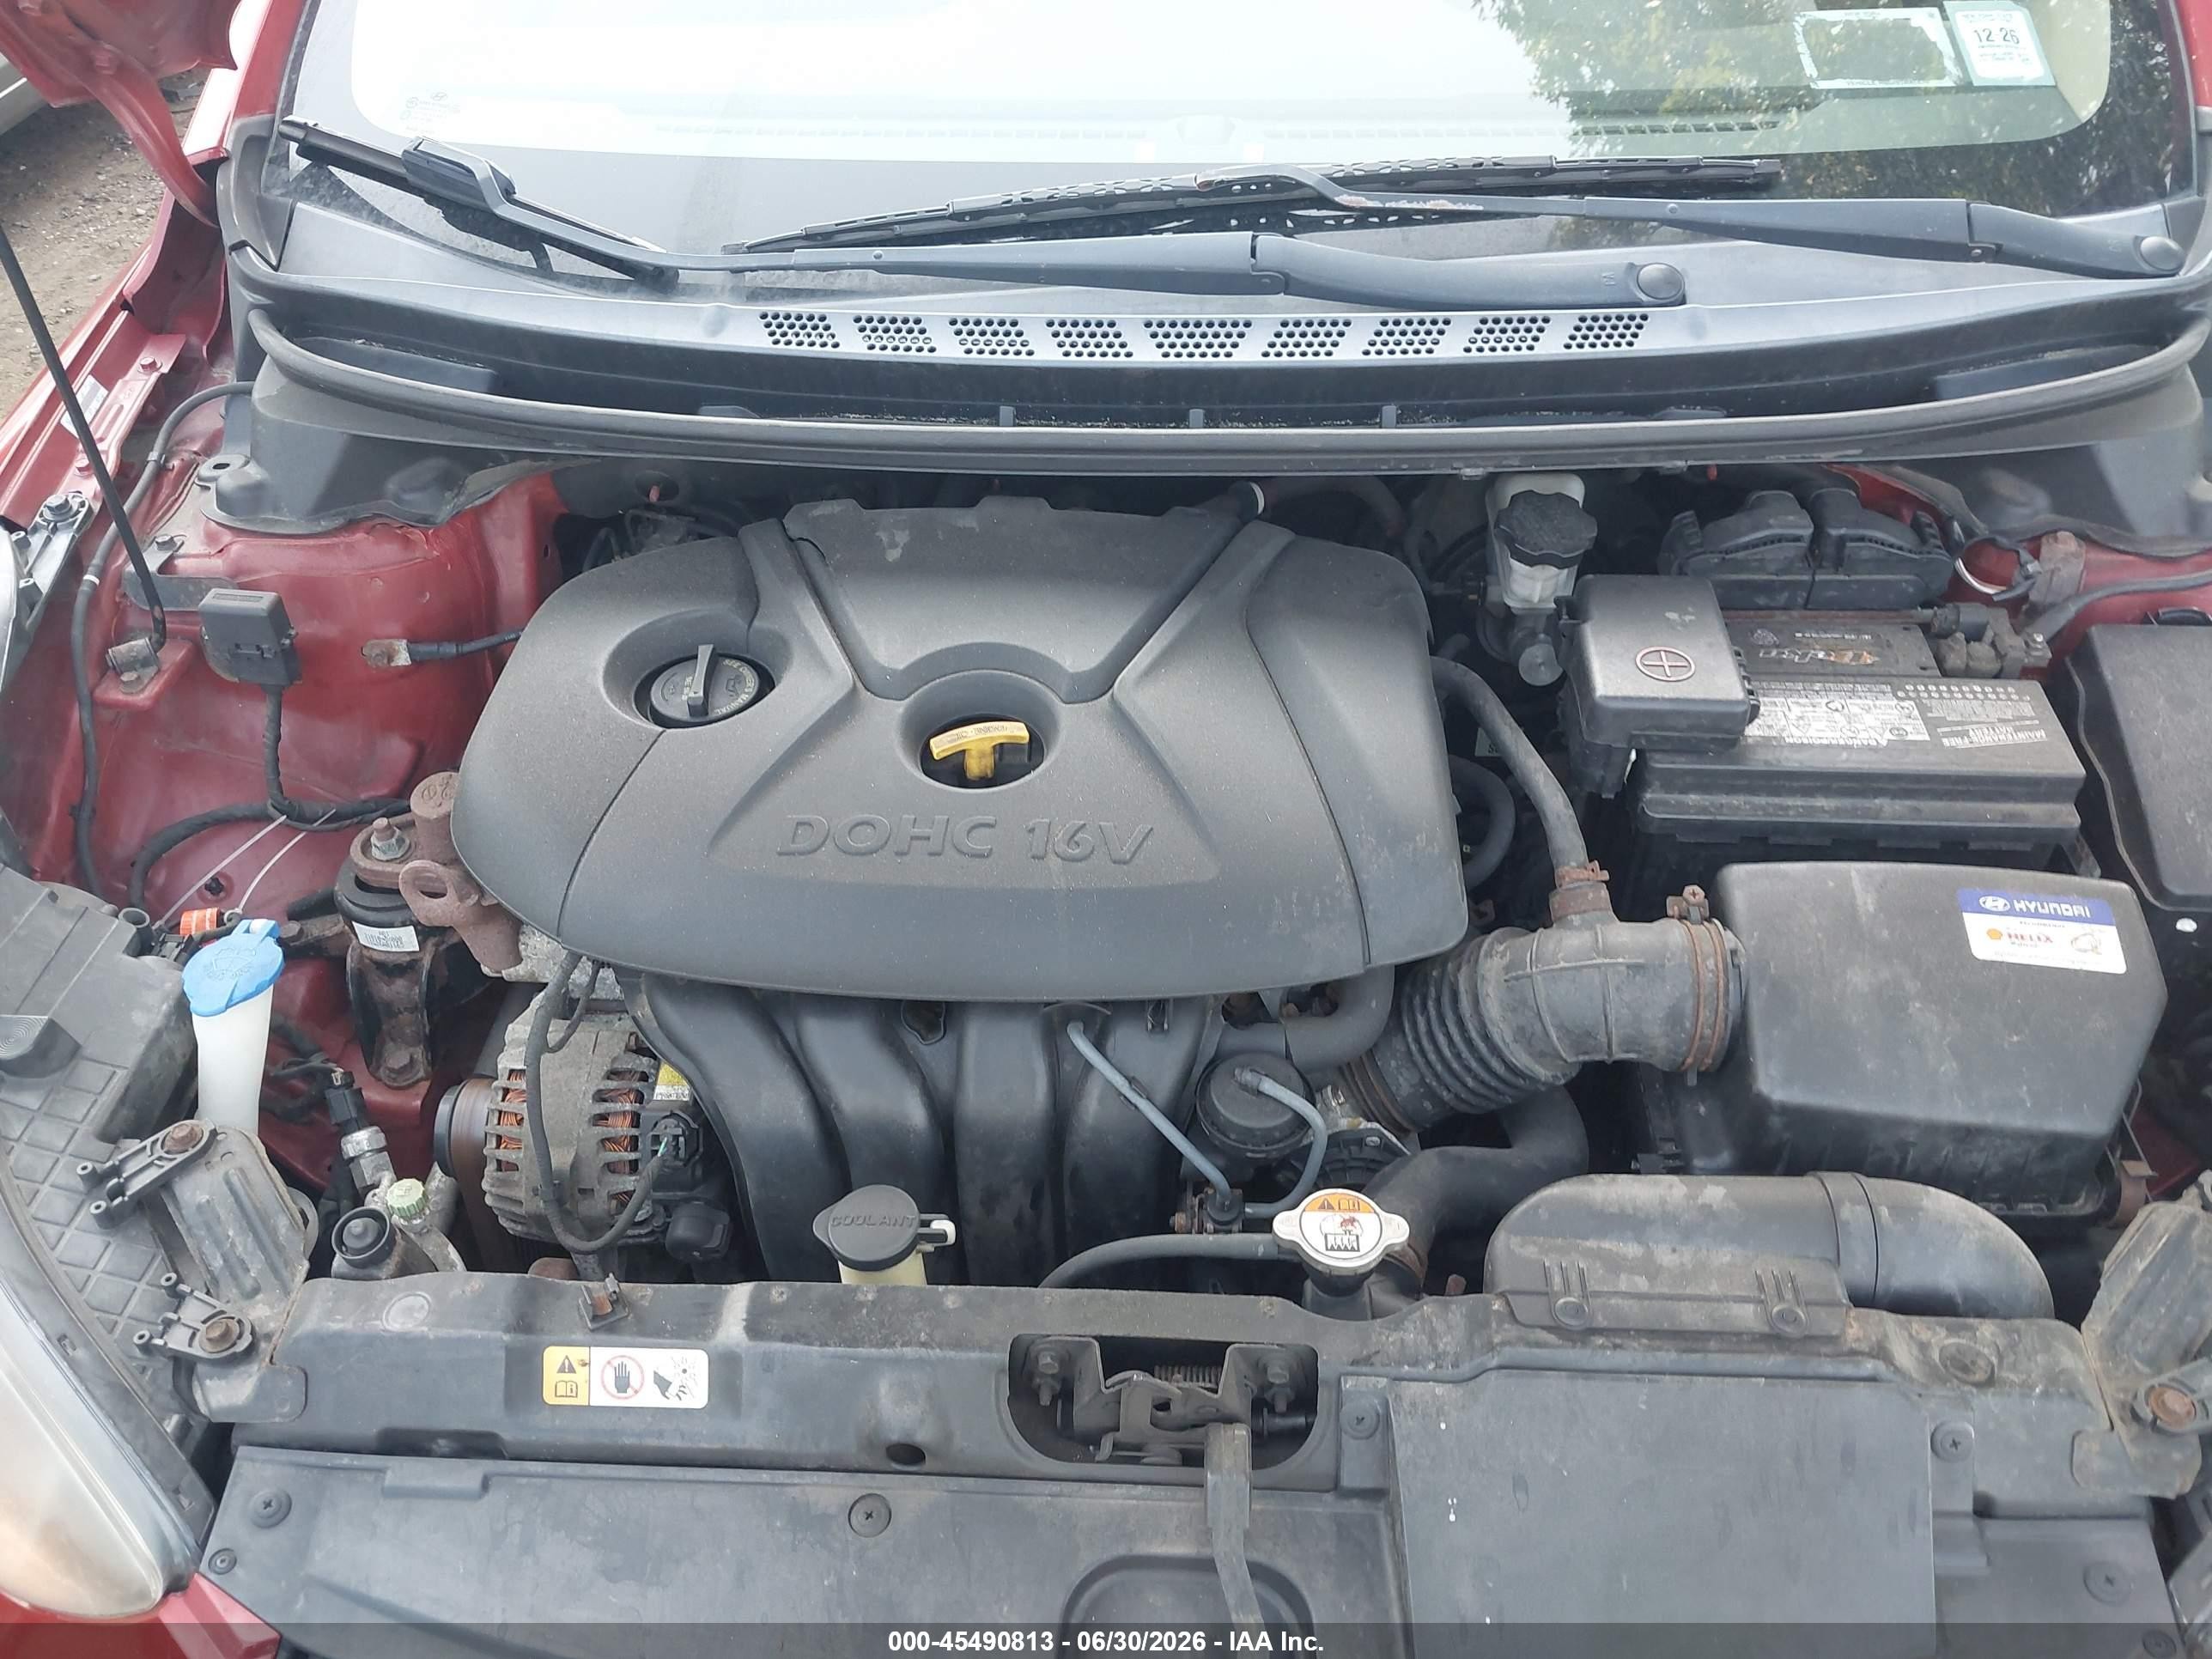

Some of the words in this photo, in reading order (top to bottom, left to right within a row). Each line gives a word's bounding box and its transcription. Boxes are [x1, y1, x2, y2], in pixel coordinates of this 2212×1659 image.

[1973, 27, 2021, 46] 12-26
[776, 814, 997, 858] DOHC
[1025, 818, 1155, 864] 16V
[2014, 899, 2091, 918] HYUNDAI
[831, 1215, 916, 1228] COOLANT
